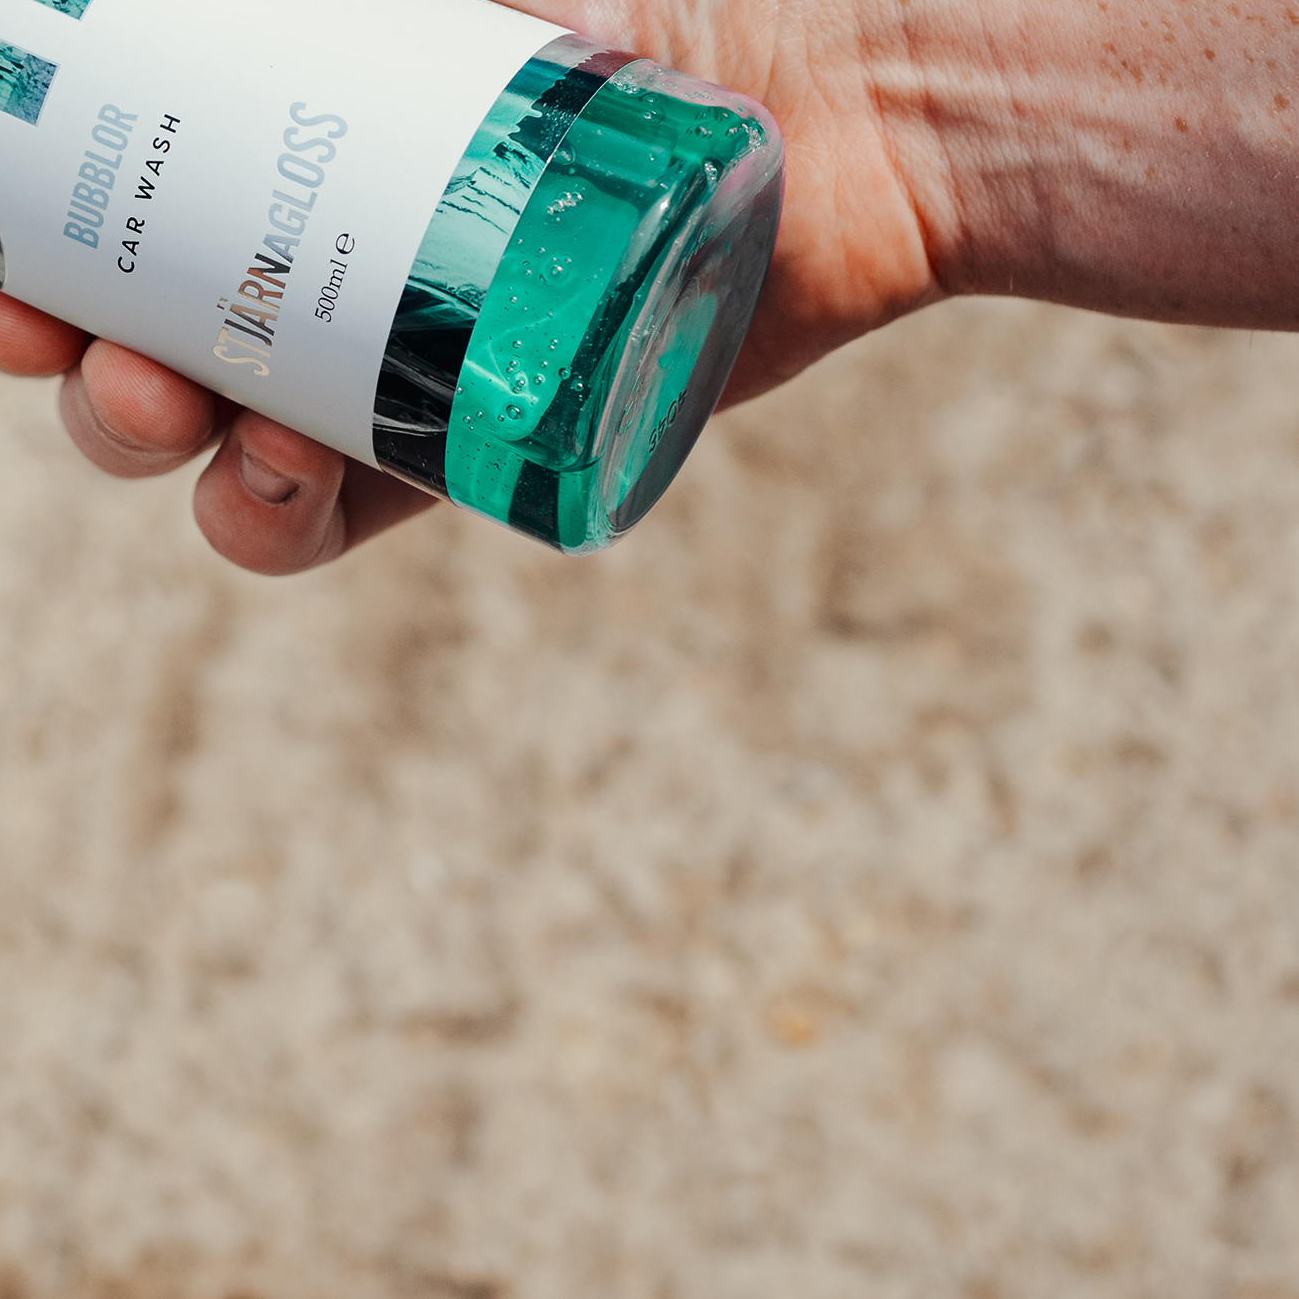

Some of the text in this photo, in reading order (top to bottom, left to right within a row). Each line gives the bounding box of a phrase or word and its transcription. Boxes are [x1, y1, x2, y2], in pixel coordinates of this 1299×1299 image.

[63, 103, 139, 249] BUBBLOR
[117, 112, 182, 275] CAR WASH
[212, 101, 348, 377] STJÄRNAGLOSS
[314, 259, 348, 323] 500ml
